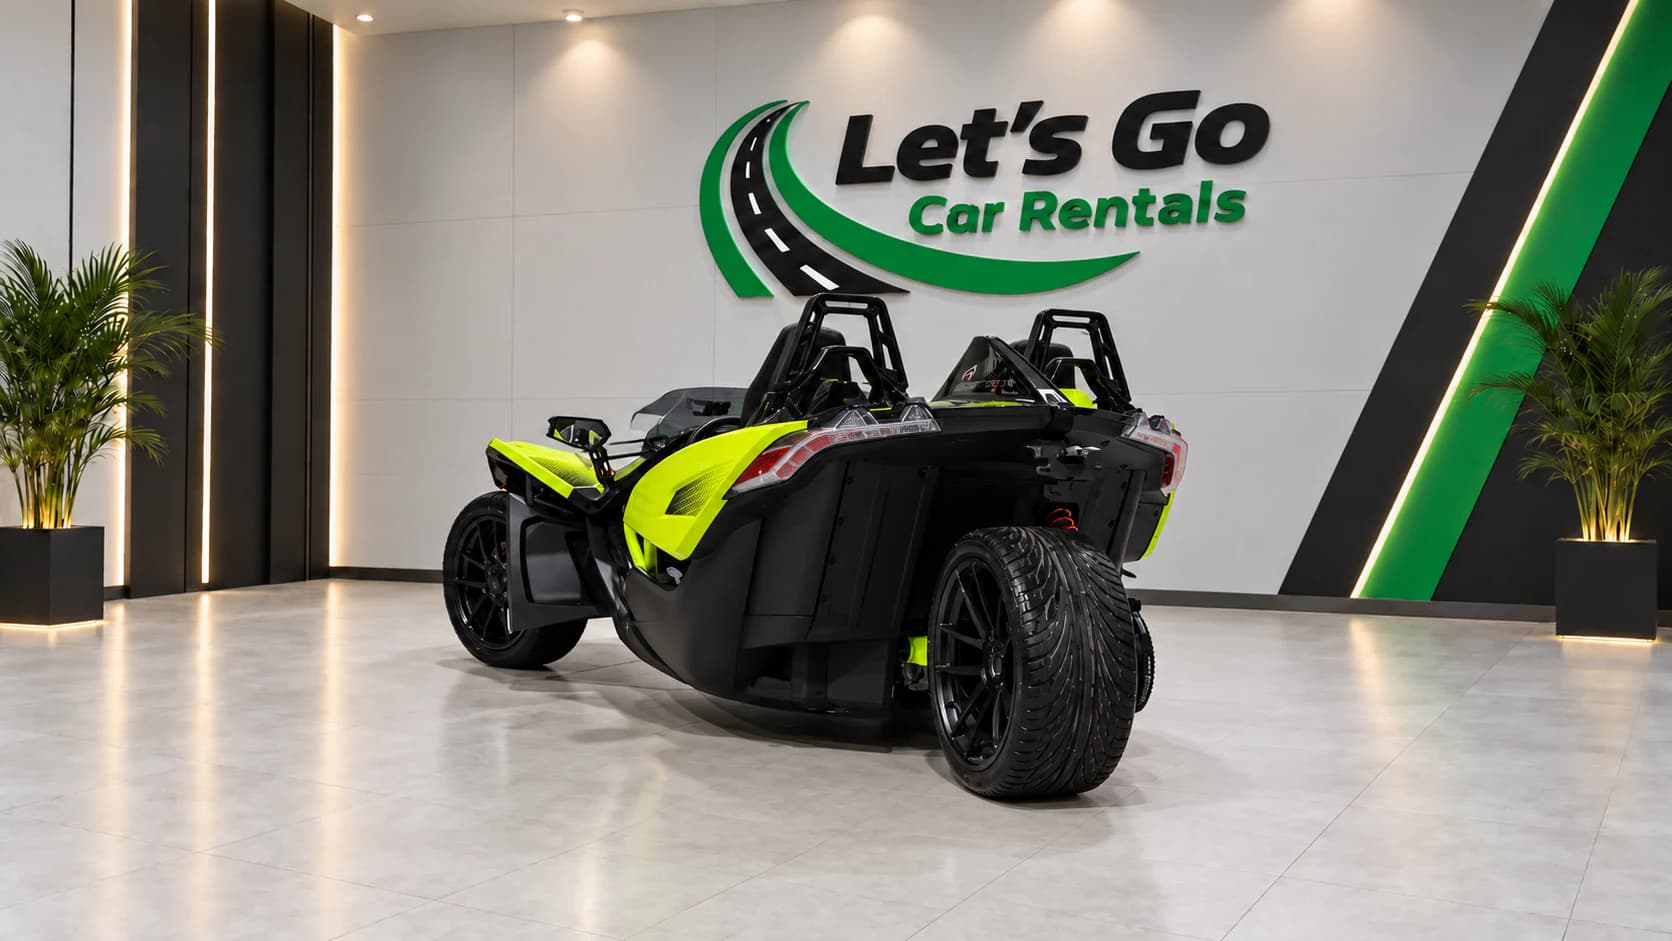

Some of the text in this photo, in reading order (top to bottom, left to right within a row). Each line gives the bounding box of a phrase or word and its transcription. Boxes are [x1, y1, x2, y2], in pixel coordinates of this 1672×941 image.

[836, 90, 1270, 185] Let's Go
[909, 179, 1246, 235] Car Rentals
